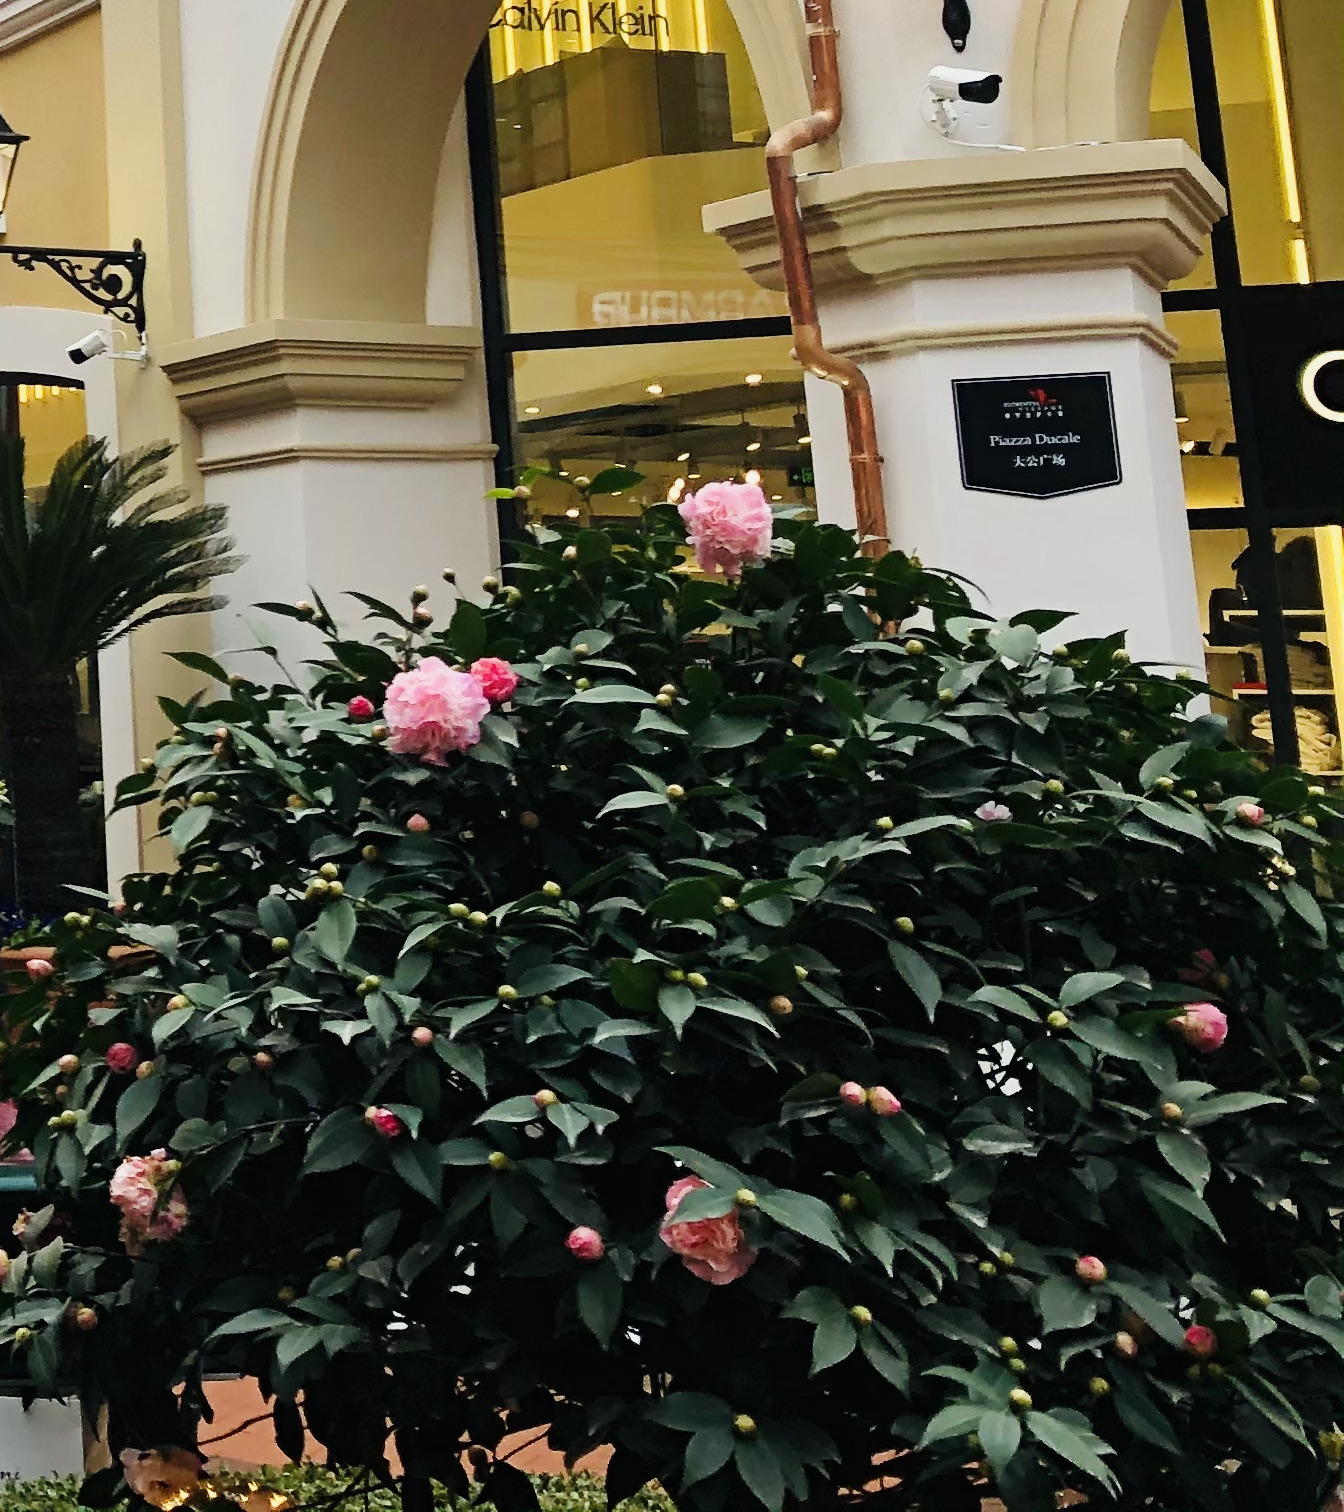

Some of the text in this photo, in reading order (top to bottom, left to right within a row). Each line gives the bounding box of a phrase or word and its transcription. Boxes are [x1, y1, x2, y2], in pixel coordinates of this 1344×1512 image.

[589, 2, 670, 38] Klein
[989, 432, 1081, 447] Piazza Ducale
